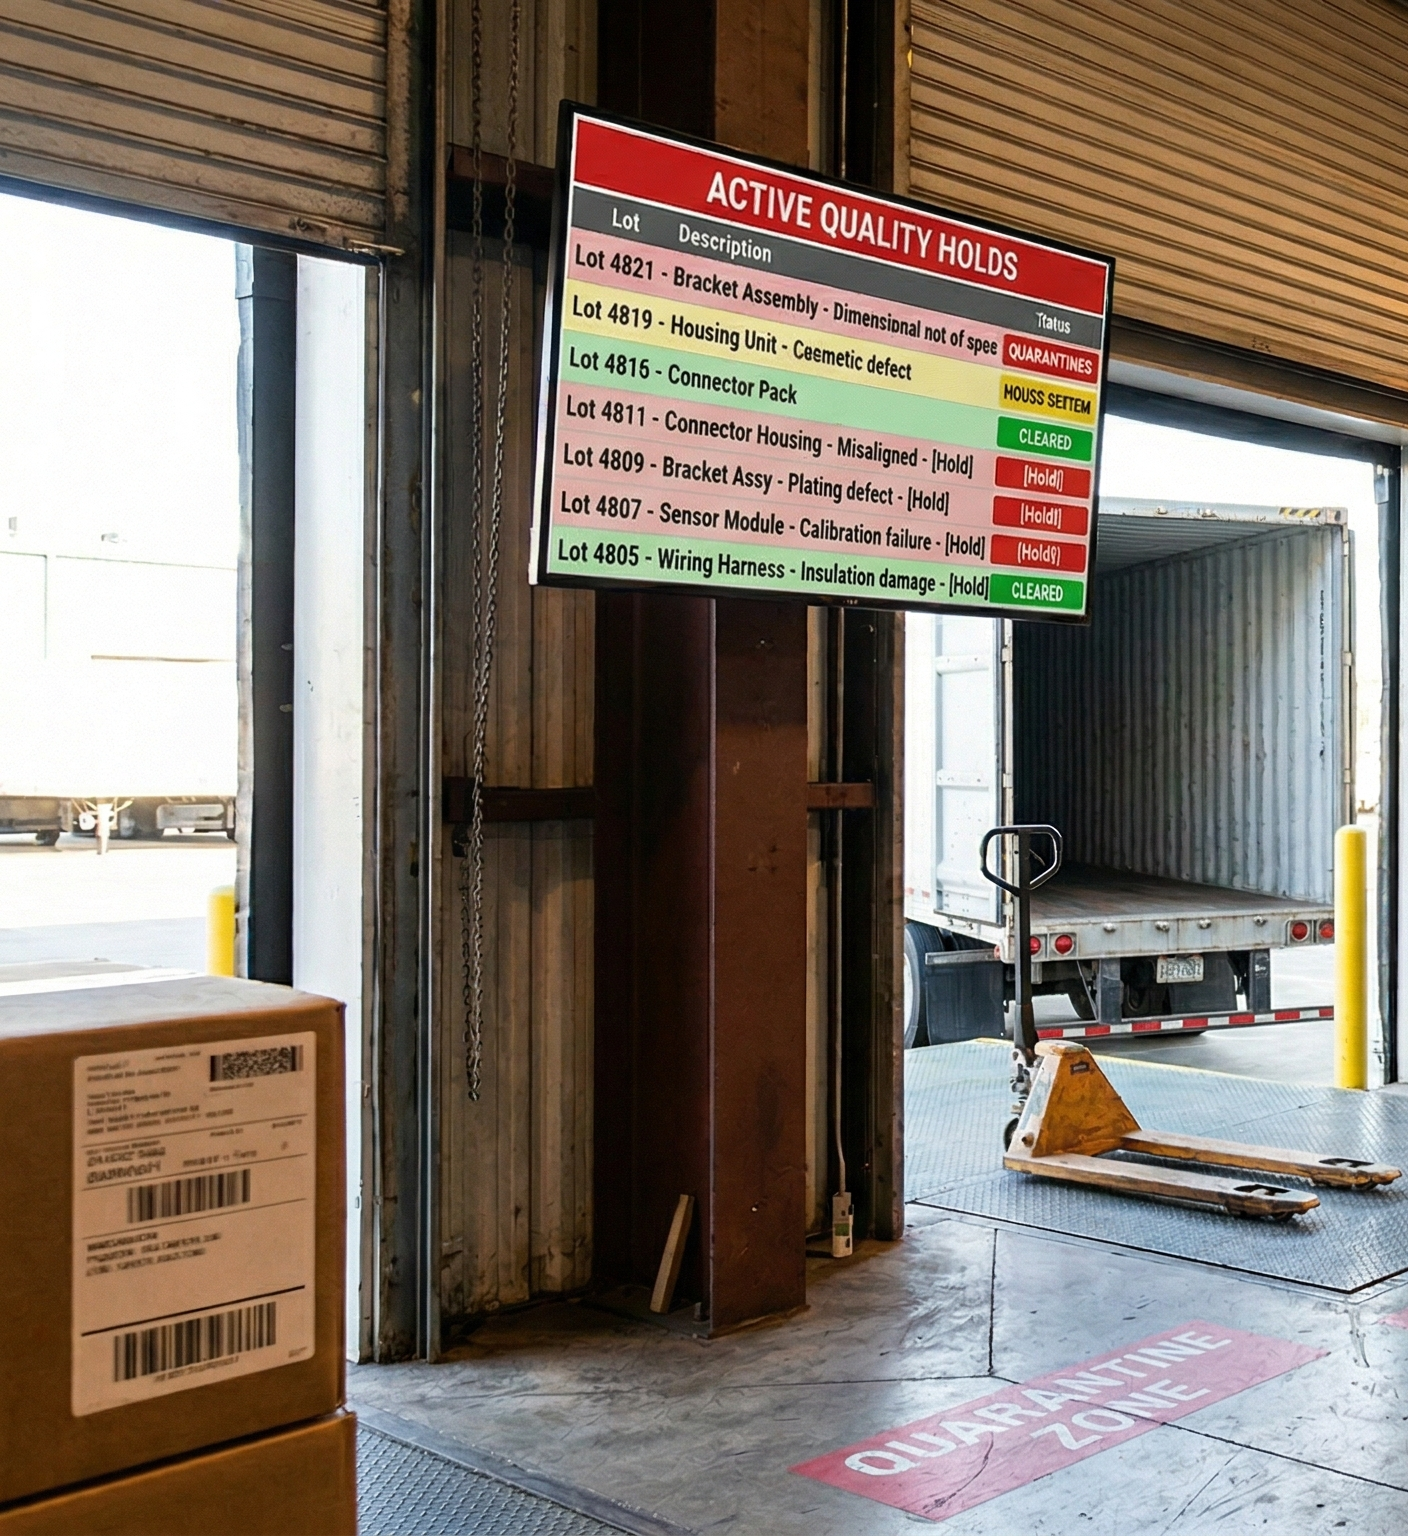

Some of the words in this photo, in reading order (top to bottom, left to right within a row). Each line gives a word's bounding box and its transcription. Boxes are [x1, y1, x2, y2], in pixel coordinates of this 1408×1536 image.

[612, 207, 640, 233] Lot
[678, 223, 772, 263] Description
[706, 171, 813, 229] ACTIVE
[820, 201, 933, 258] QUALITY
[938, 232, 1018, 281] HOLDS
[575, 243, 605, 271] Lot
[609, 252, 653, 281] 4821
[673, 265, 739, 300] Bracket
[741, 282, 819, 321] Assembly
[924, 326, 947, 345] not
[949, 329, 965, 348] of
[572, 294, 602, 321] Lot
[607, 302, 653, 330] 4819
[670, 314, 740, 352] Housing
[744, 329, 778, 355] Unit
[866, 354, 912, 381] defect
[1008, 342, 1093, 375] QUARANTINES
[569, 346, 599, 371] Lot
[604, 353, 650, 380] 4816
[668, 363, 755, 397] Connector
[758, 379, 798, 405] Pack
[566, 394, 596, 420] Lot
[601, 400, 645, 427] 4811
[664, 410, 753, 443] Connector
[756, 424, 822, 458] Housing
[837, 436, 918, 469] Misaligned
[931, 448, 974, 480] [Hold]
[1019, 427, 1072, 451] CLEARED
[563, 442, 594, 468] Lot
[598, 447, 645, 474] 4809
[662, 455, 729, 485] Bracket
[731, 465, 773, 496] Assy
[788, 472, 843, 505] Plating
[846, 480, 894, 506] defect
[907, 486, 950, 517] [Hold]
[561, 490, 591, 515] Lot
[595, 494, 642, 520] 4807
[659, 501, 720, 528] Sensor
[724, 509, 785, 536] Module
[799, 517, 882, 546] Calibration
[885, 526, 932, 551] failure
[944, 531, 986, 561] [Hold]
[558, 538, 588, 563] Lot
[593, 542, 640, 567] 4805
[657, 547, 713, 579] Wiring
[717, 553, 785, 579] Harness
[800, 560, 875, 587] Insulation
[878, 567, 936, 597] damage
[948, 572, 990, 601] [Hold]
[1011, 581, 1064, 602] CLEARED
[844, 1331, 1232, 1477] QUARANTINE
[1031, 1379, 1210, 1451] ZONE
